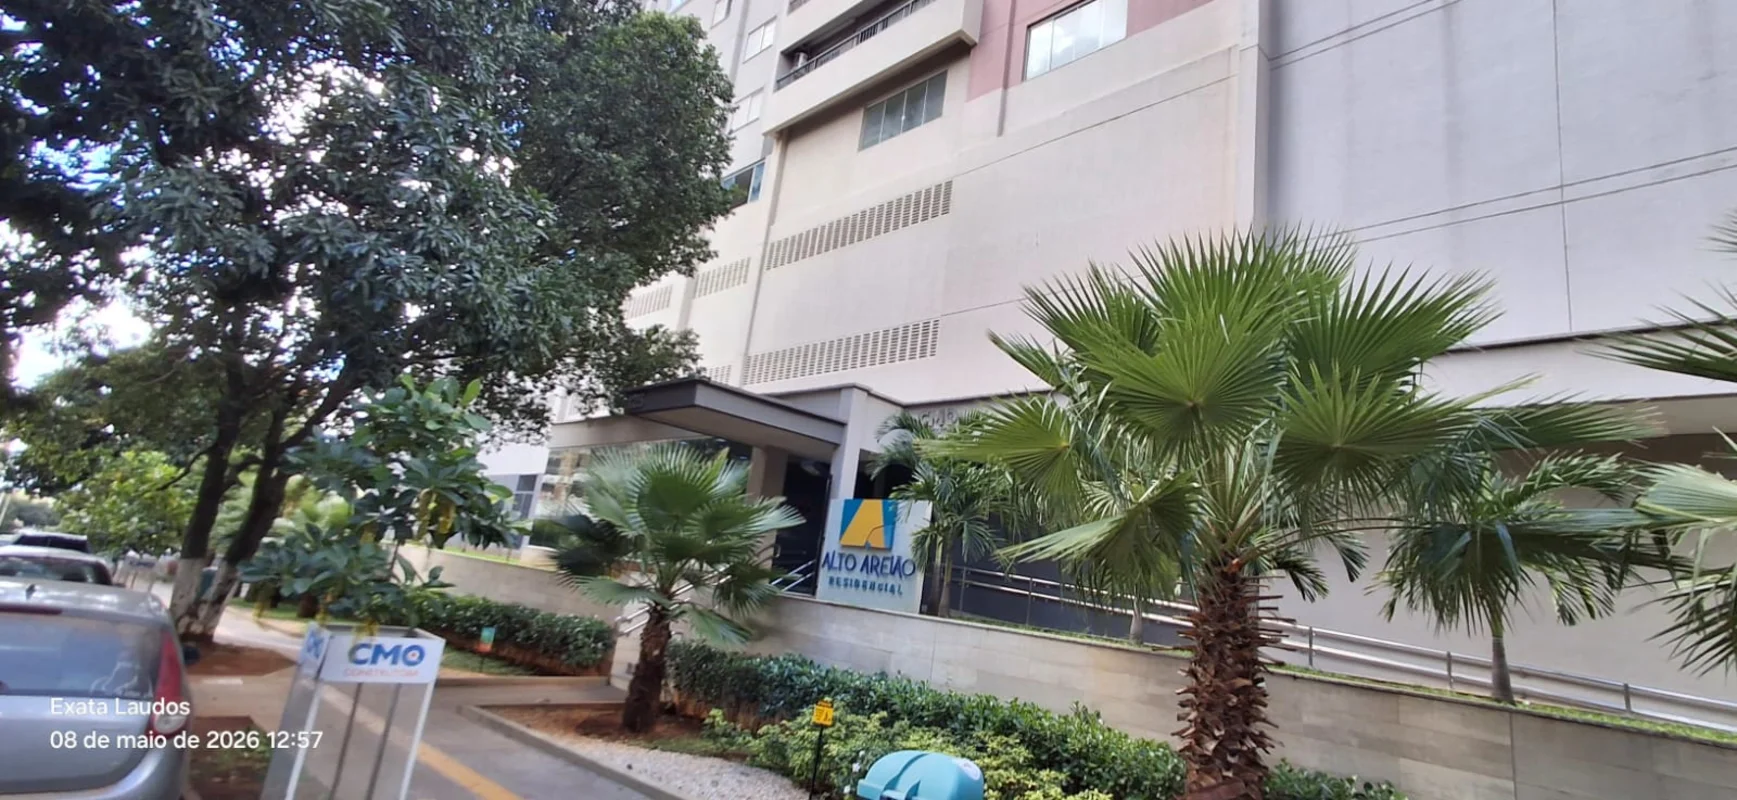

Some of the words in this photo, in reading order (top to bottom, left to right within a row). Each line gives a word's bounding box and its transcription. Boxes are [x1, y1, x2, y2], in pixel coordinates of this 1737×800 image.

[821, 550, 857, 572] ALTO
[828, 576, 903, 595] RESIDENCIAL
[348, 643, 425, 666] CMO
